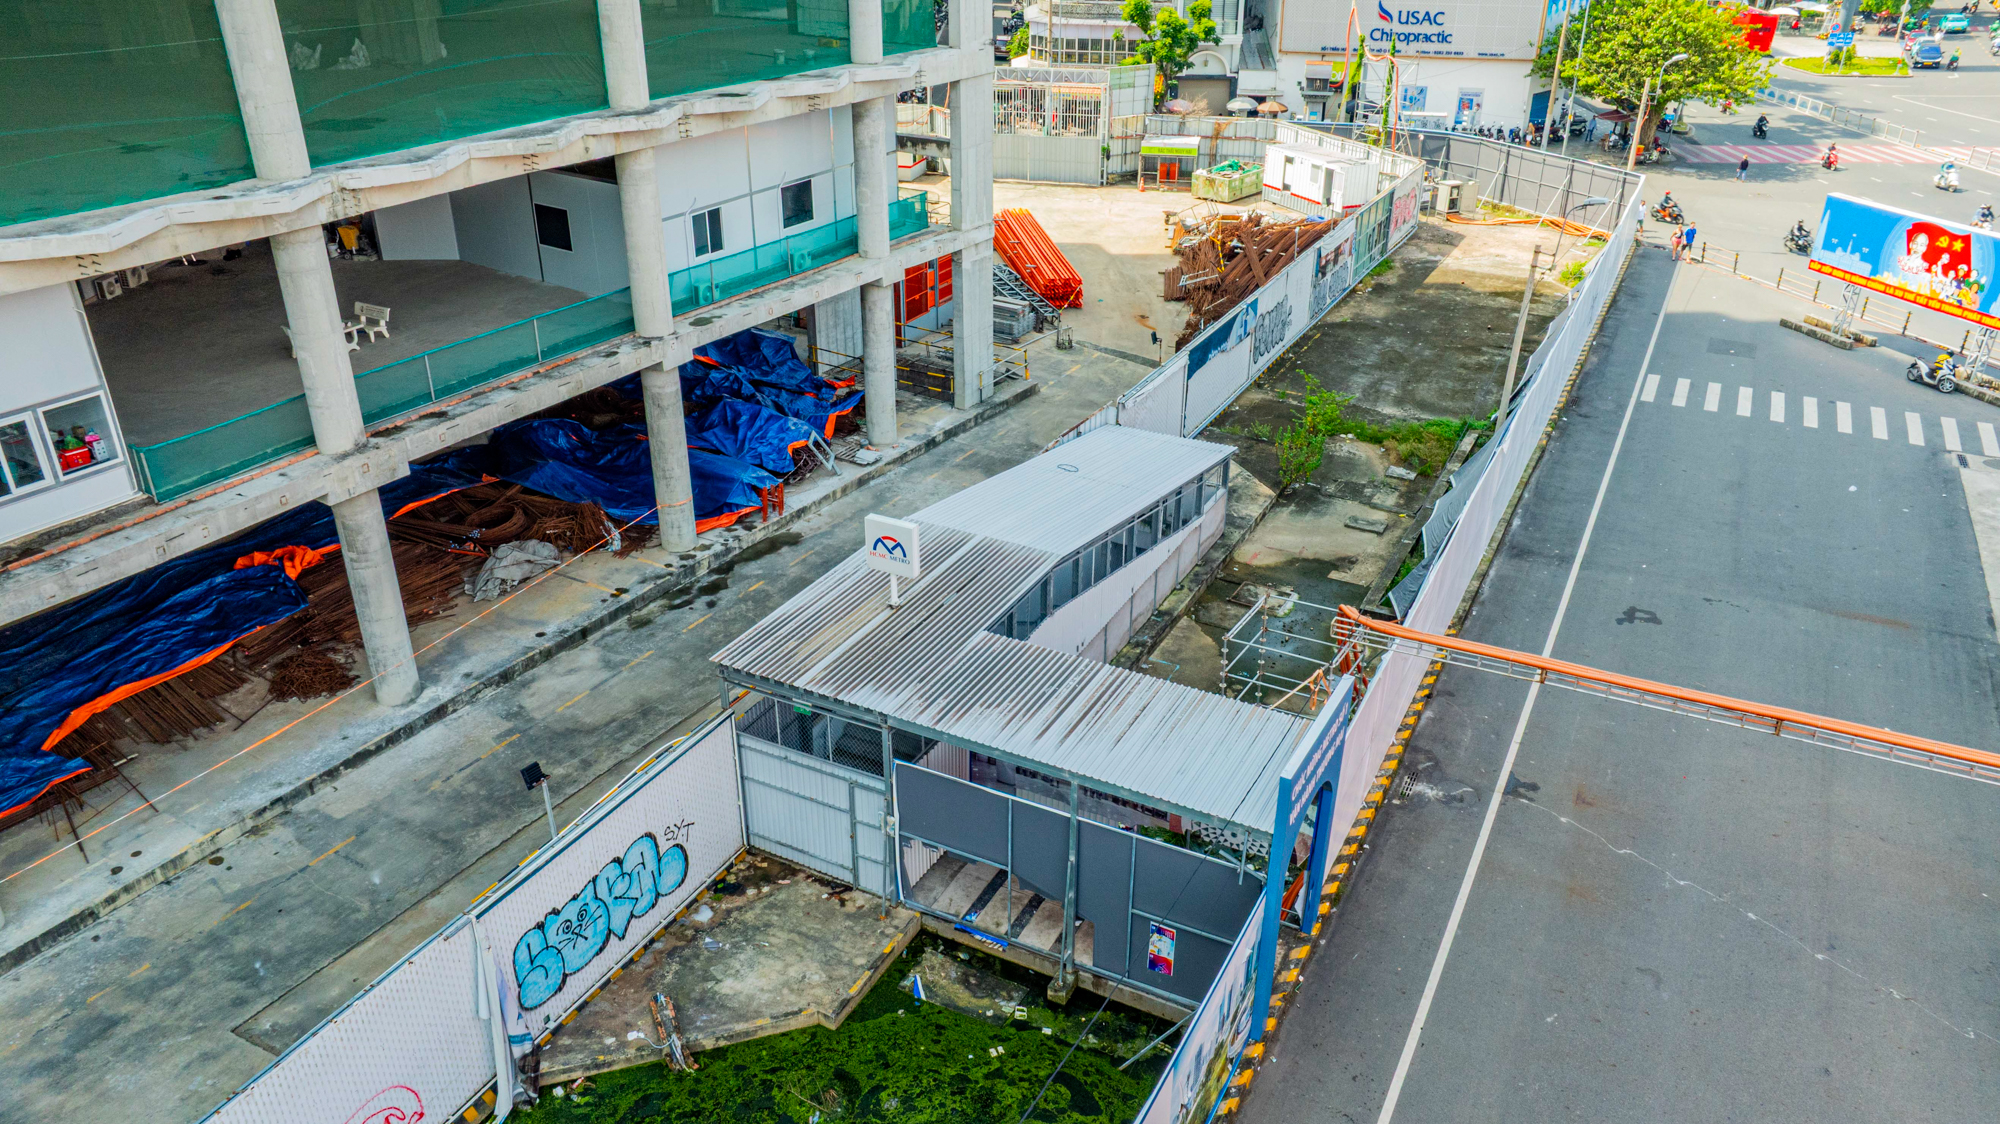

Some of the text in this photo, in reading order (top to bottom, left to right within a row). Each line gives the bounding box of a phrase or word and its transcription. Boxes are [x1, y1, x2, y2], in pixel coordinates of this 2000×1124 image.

[1398, 10, 1445, 26] USAC
[1370, 27, 1453, 45] Chiropractic
[1941, 302, 1963, 316] TRONG
[1963, 308, 1981, 321] PHÁT
[869, 551, 911, 565] HCMC METRO
